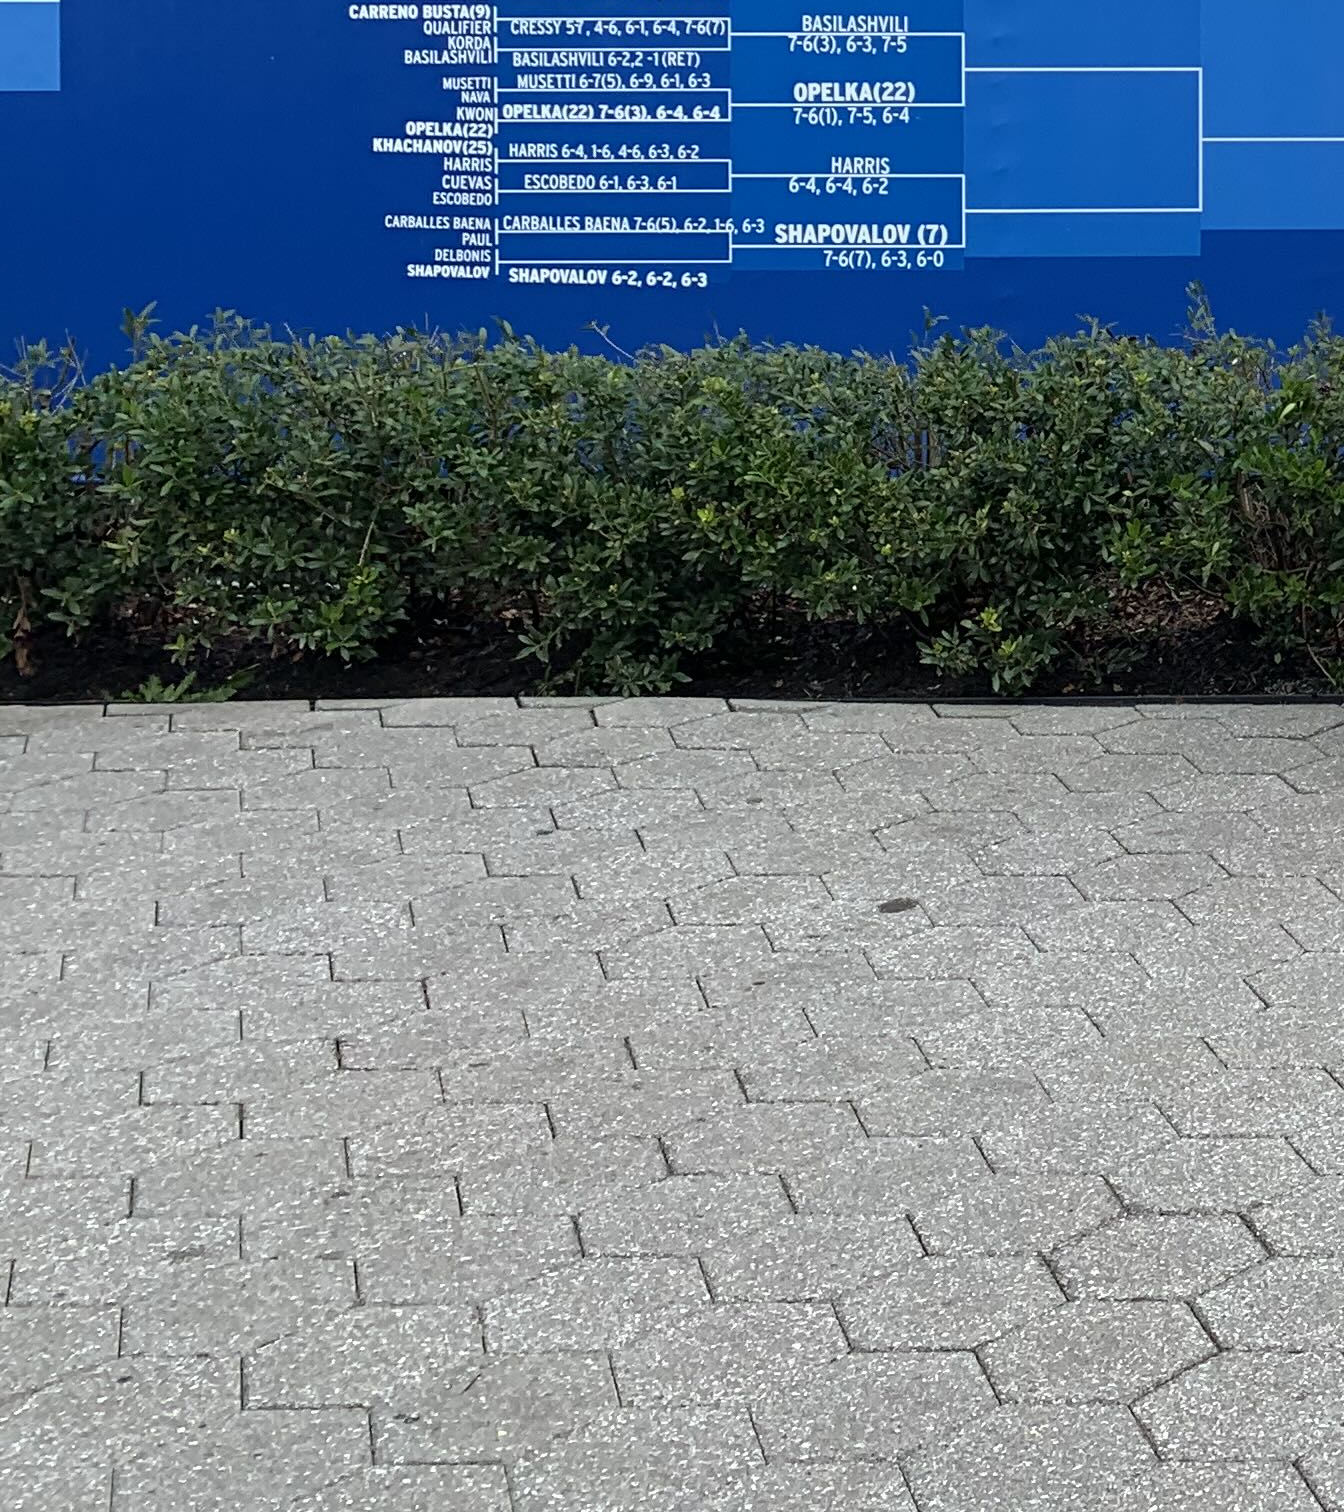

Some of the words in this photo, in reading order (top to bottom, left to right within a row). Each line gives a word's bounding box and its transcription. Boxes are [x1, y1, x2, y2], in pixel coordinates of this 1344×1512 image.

[802, 14, 909, 33] BASILASHVILI
[881, 35, 907, 53] 7-5
[793, 81, 916, 104] OPELKA(22)
[882, 106, 910, 124] 6-4
[443, 156, 493, 173] HARRIS
[831, 156, 890, 175] HARRIS
[432, 191, 493, 206] ESCOBEDO
[461, 232, 493, 247] PAUL
[774, 223, 911, 244] SHAPOVALOV
[917, 223, 948, 245] (7)
[916, 250, 944, 268] 6-0
[406, 263, 491, 279] SHAPOVALOV
[508, 267, 608, 285] SHAPOVALOV
[680, 271, 708, 288] 6-3
